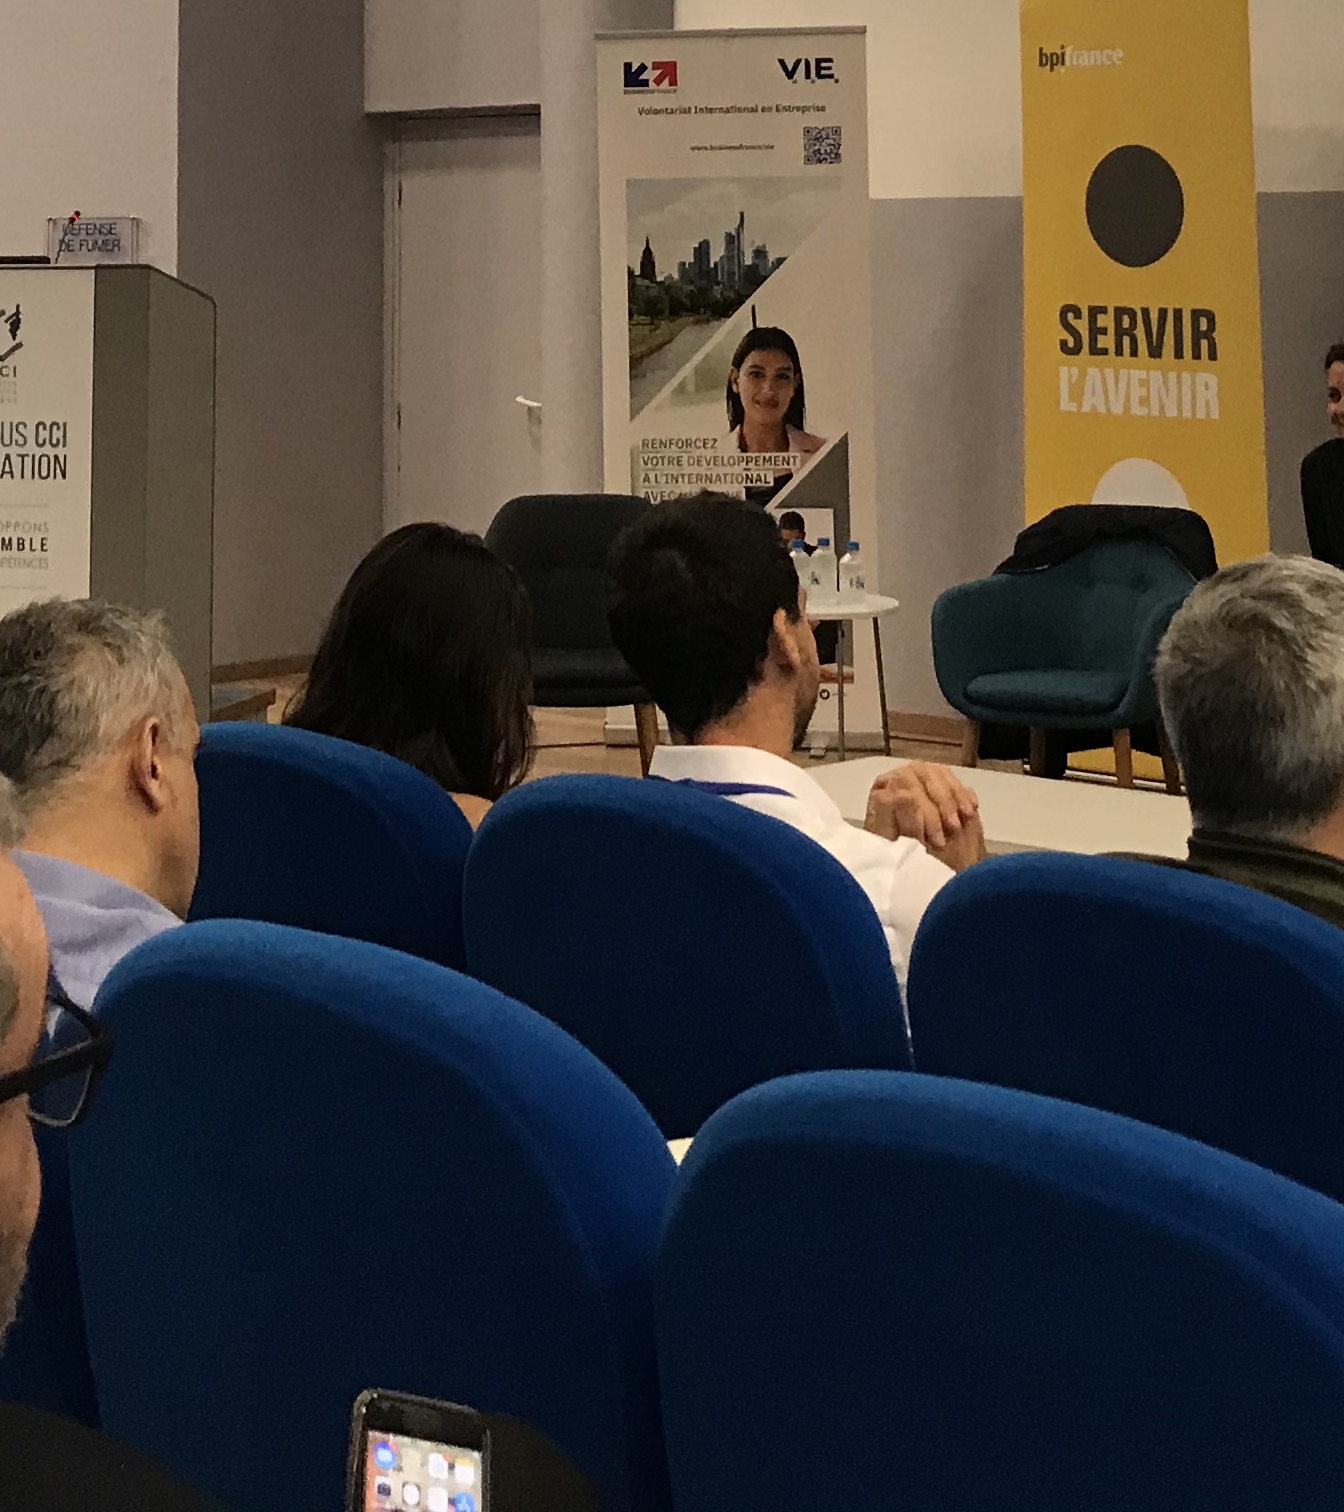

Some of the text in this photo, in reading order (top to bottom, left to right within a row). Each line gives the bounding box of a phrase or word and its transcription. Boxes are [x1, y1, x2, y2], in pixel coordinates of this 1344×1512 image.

[1038, 45, 1124, 72] bpifrance
[637, 105, 692, 116] Volontariat
[693, 104, 759, 115] International
[775, 103, 827, 115] Entreprise
[59, 239, 120, 252] DE FUMER
[1059, 303, 1218, 362] SERVIR
[35, 420, 68, 448] CCI
[641, 438, 718, 450] RENFORCEZ
[642, 455, 684, 467] VOTRE
